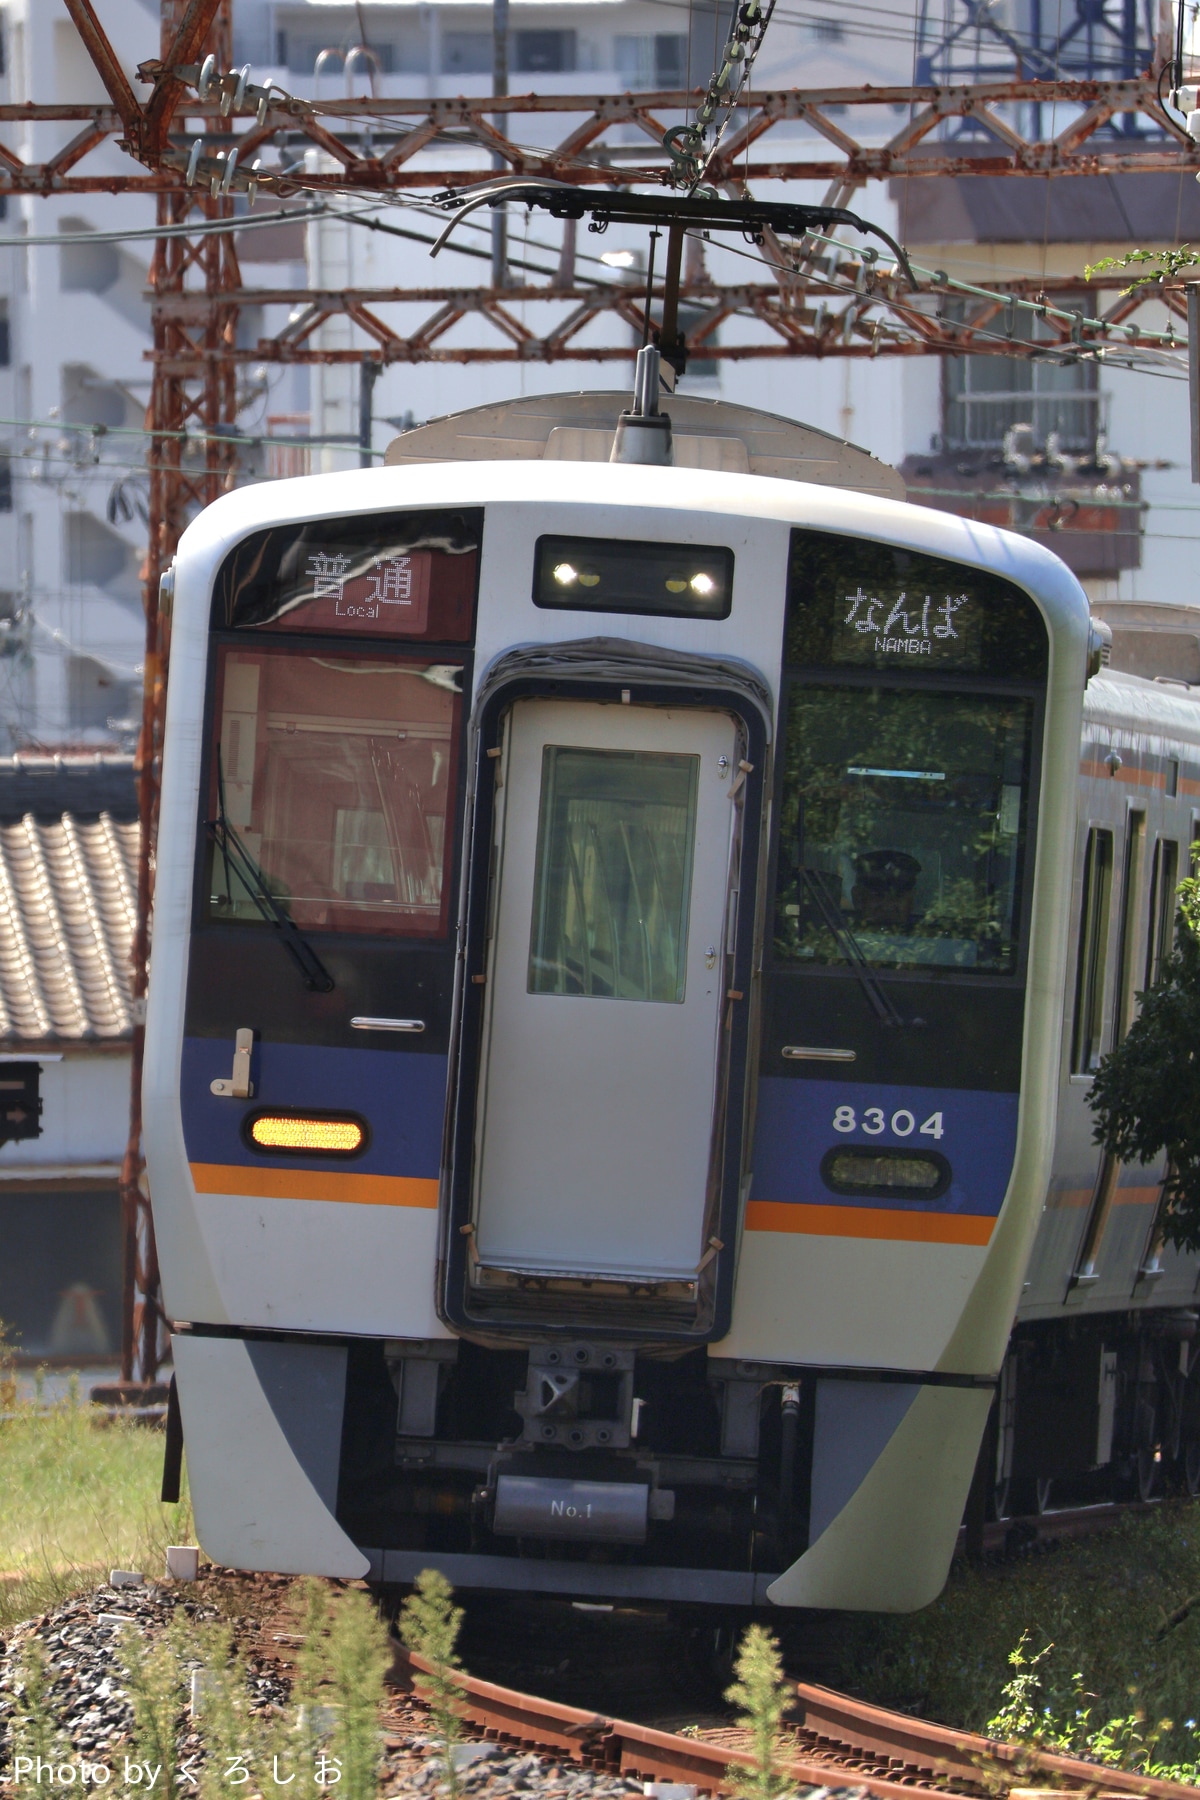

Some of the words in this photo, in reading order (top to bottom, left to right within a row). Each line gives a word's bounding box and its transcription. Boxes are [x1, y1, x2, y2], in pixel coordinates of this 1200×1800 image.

[304, 551, 412, 605] 普通
[335, 601, 379, 618] Local
[843, 587, 969, 639] なんば
[874, 636, 932, 655] NAMBA
[832, 1105, 944, 1139] 8304
[551, 1500, 592, 1518] No.1
